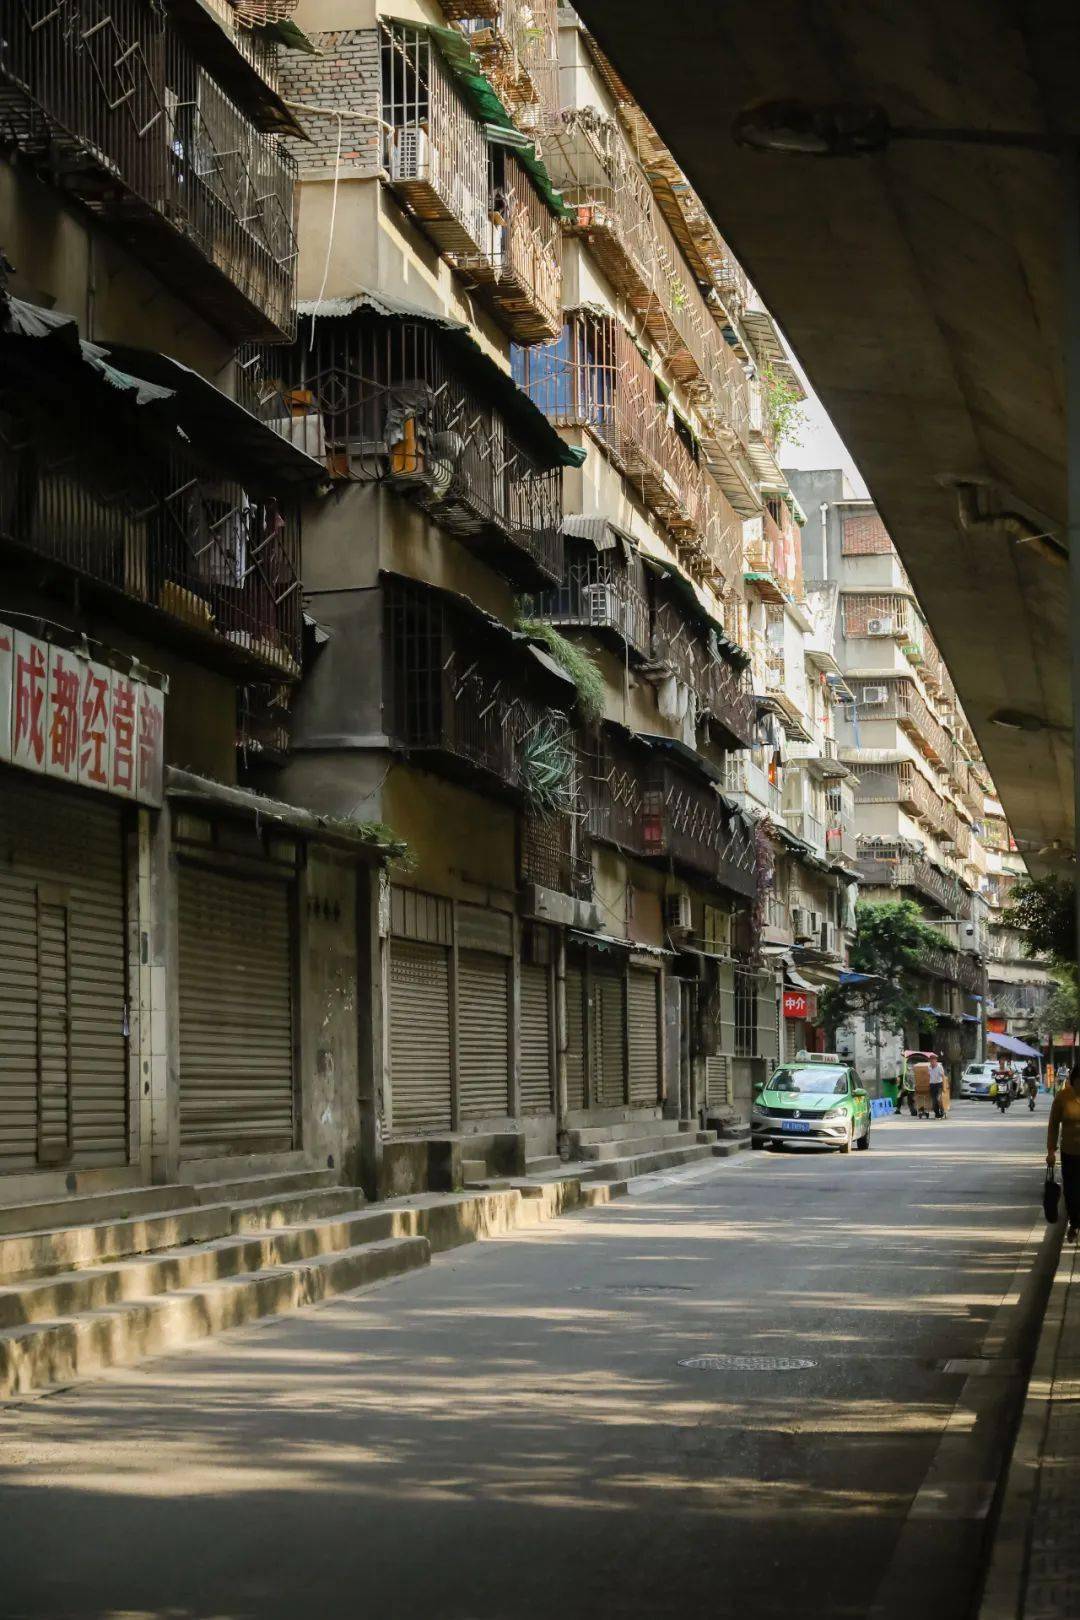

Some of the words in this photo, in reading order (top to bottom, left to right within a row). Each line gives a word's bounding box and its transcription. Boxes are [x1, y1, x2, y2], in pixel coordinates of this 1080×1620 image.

[0, 637, 162, 791] 成都经营部
[785, 997, 805, 1010] 中介
